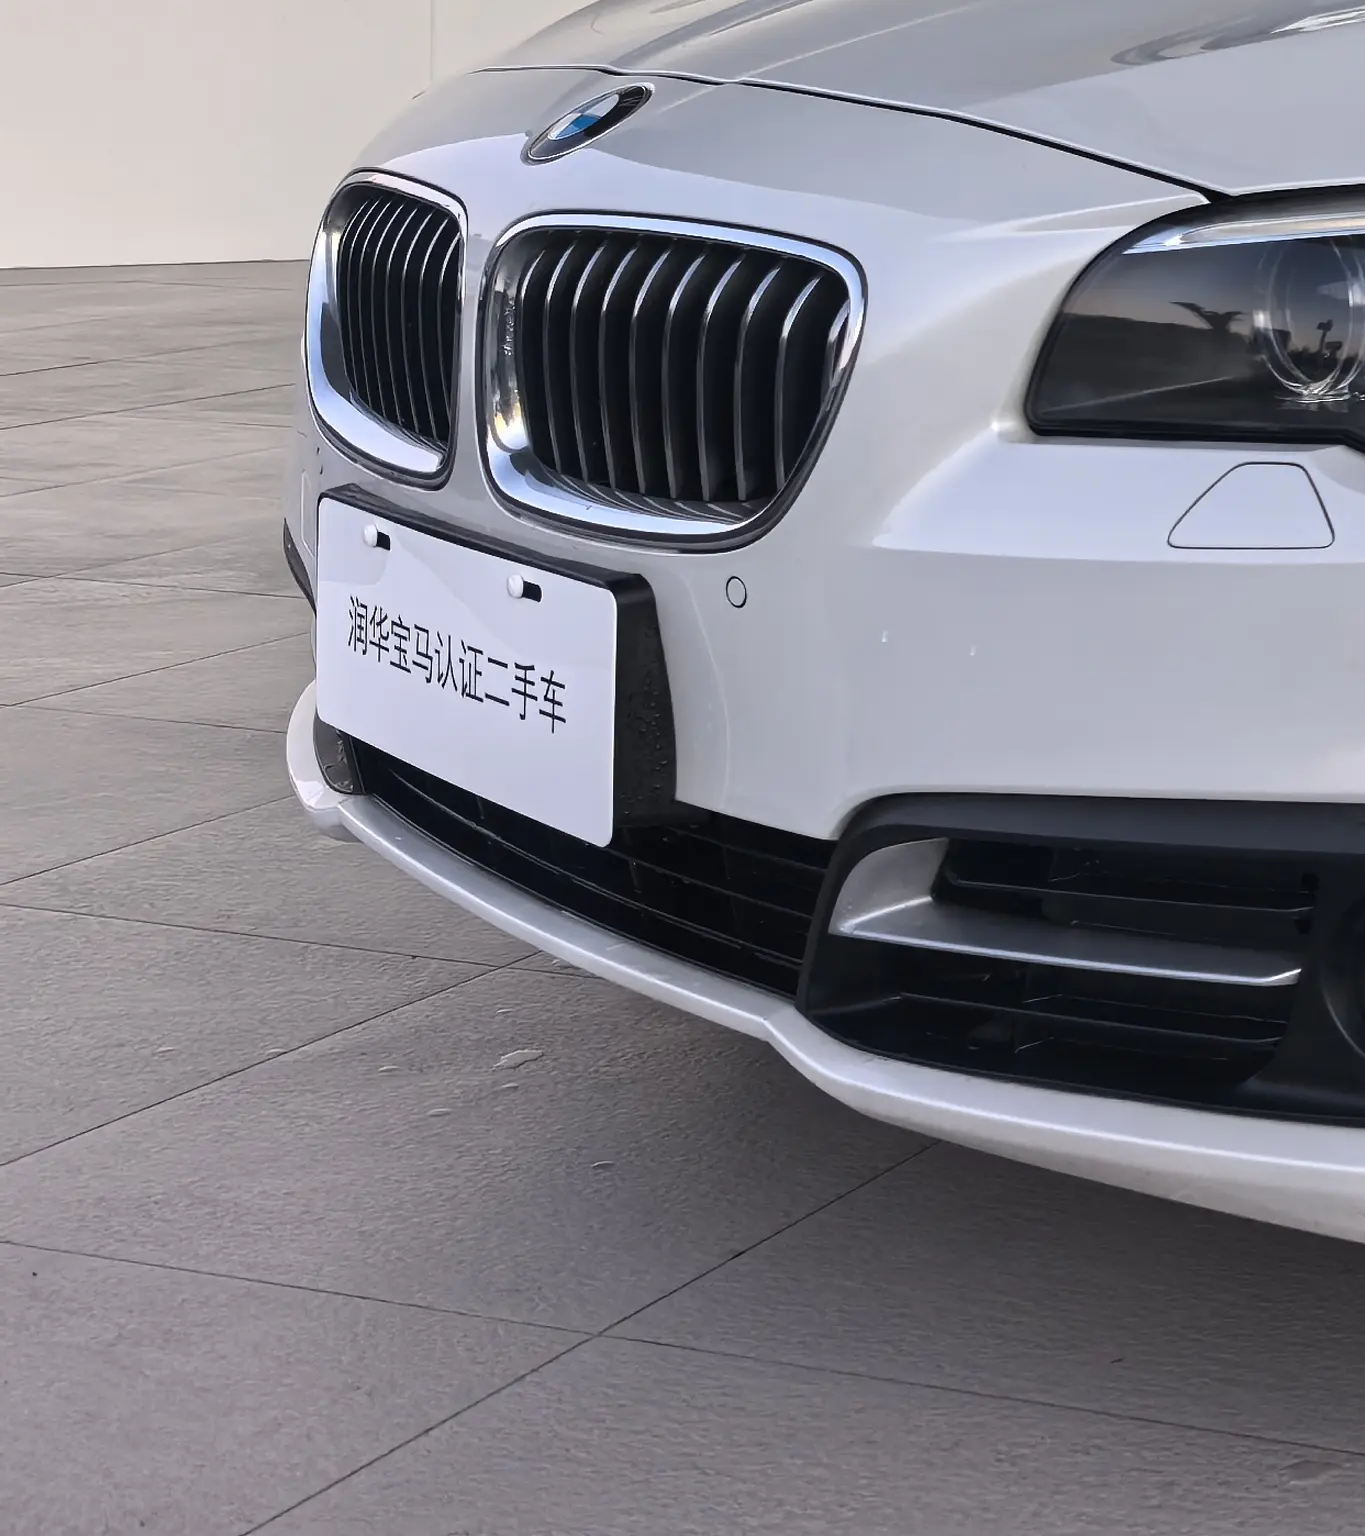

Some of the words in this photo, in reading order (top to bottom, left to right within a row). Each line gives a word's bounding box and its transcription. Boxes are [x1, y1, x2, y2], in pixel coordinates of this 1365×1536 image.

[347, 595, 567, 734] 润华宝马认证二手车
